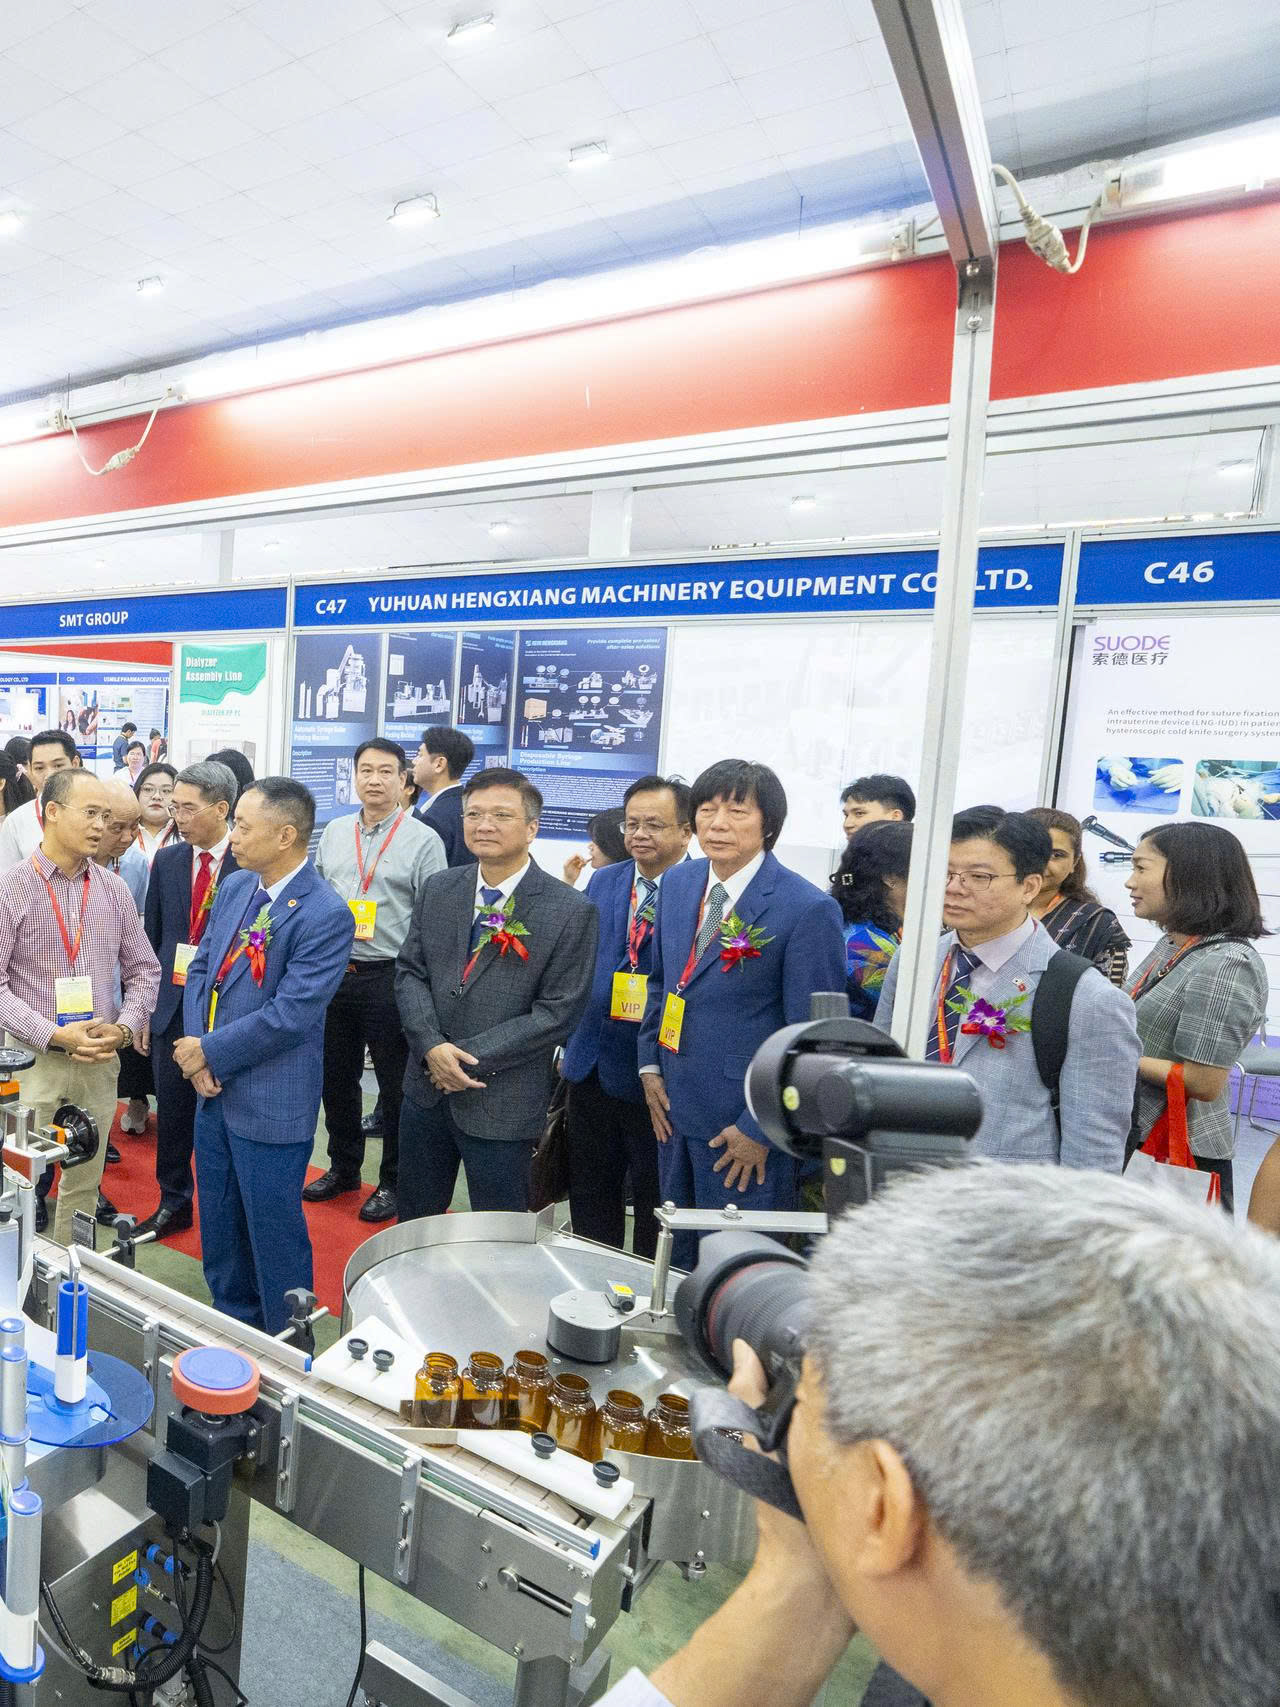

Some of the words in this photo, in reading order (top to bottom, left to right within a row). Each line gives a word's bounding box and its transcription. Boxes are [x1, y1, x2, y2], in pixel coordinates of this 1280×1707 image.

[1143, 560, 1215, 586] C46
[368, 593, 447, 613] YUHUAN
[452, 587, 579, 610] HENGXIANG
[581, 580, 725, 605] MACHINERY
[729, 573, 896, 601] EQUIPMENT
[973, 567, 1034, 592] LTD.
[315, 598, 347, 615] C47
[59, 613, 84, 628] SMT
[86, 611, 129, 626] GROUP
[1093, 634, 1171, 651] SUODE
[185, 656, 218, 668] Dialyzer
[1092, 651, 1170, 666] 索德医疗
[185, 671, 223, 683] Assembly
[224, 671, 243, 681] Line
[1107, 708, 1119, 716] An
[1120, 708, 1158, 716] effective
[1159, 709, 1195, 717] method
[1196, 709, 1210, 717] for
[1243, 709, 1280, 718] fixation
[1107, 718, 1160, 726] intrauterine
[1191, 719, 1239, 728] (LNG-IUD)
[1106, 727, 1166, 737] hysteroscopic
[1167, 728, 1188, 736] cold
[1213, 730, 1249, 738] surgery
[519, 751, 556, 759] Disposable
[519, 758, 555, 766] Production
[517, 766, 547, 774] Description
[621, 1001, 641, 1014] VIP
[664, 1026, 676, 1041] VIP
